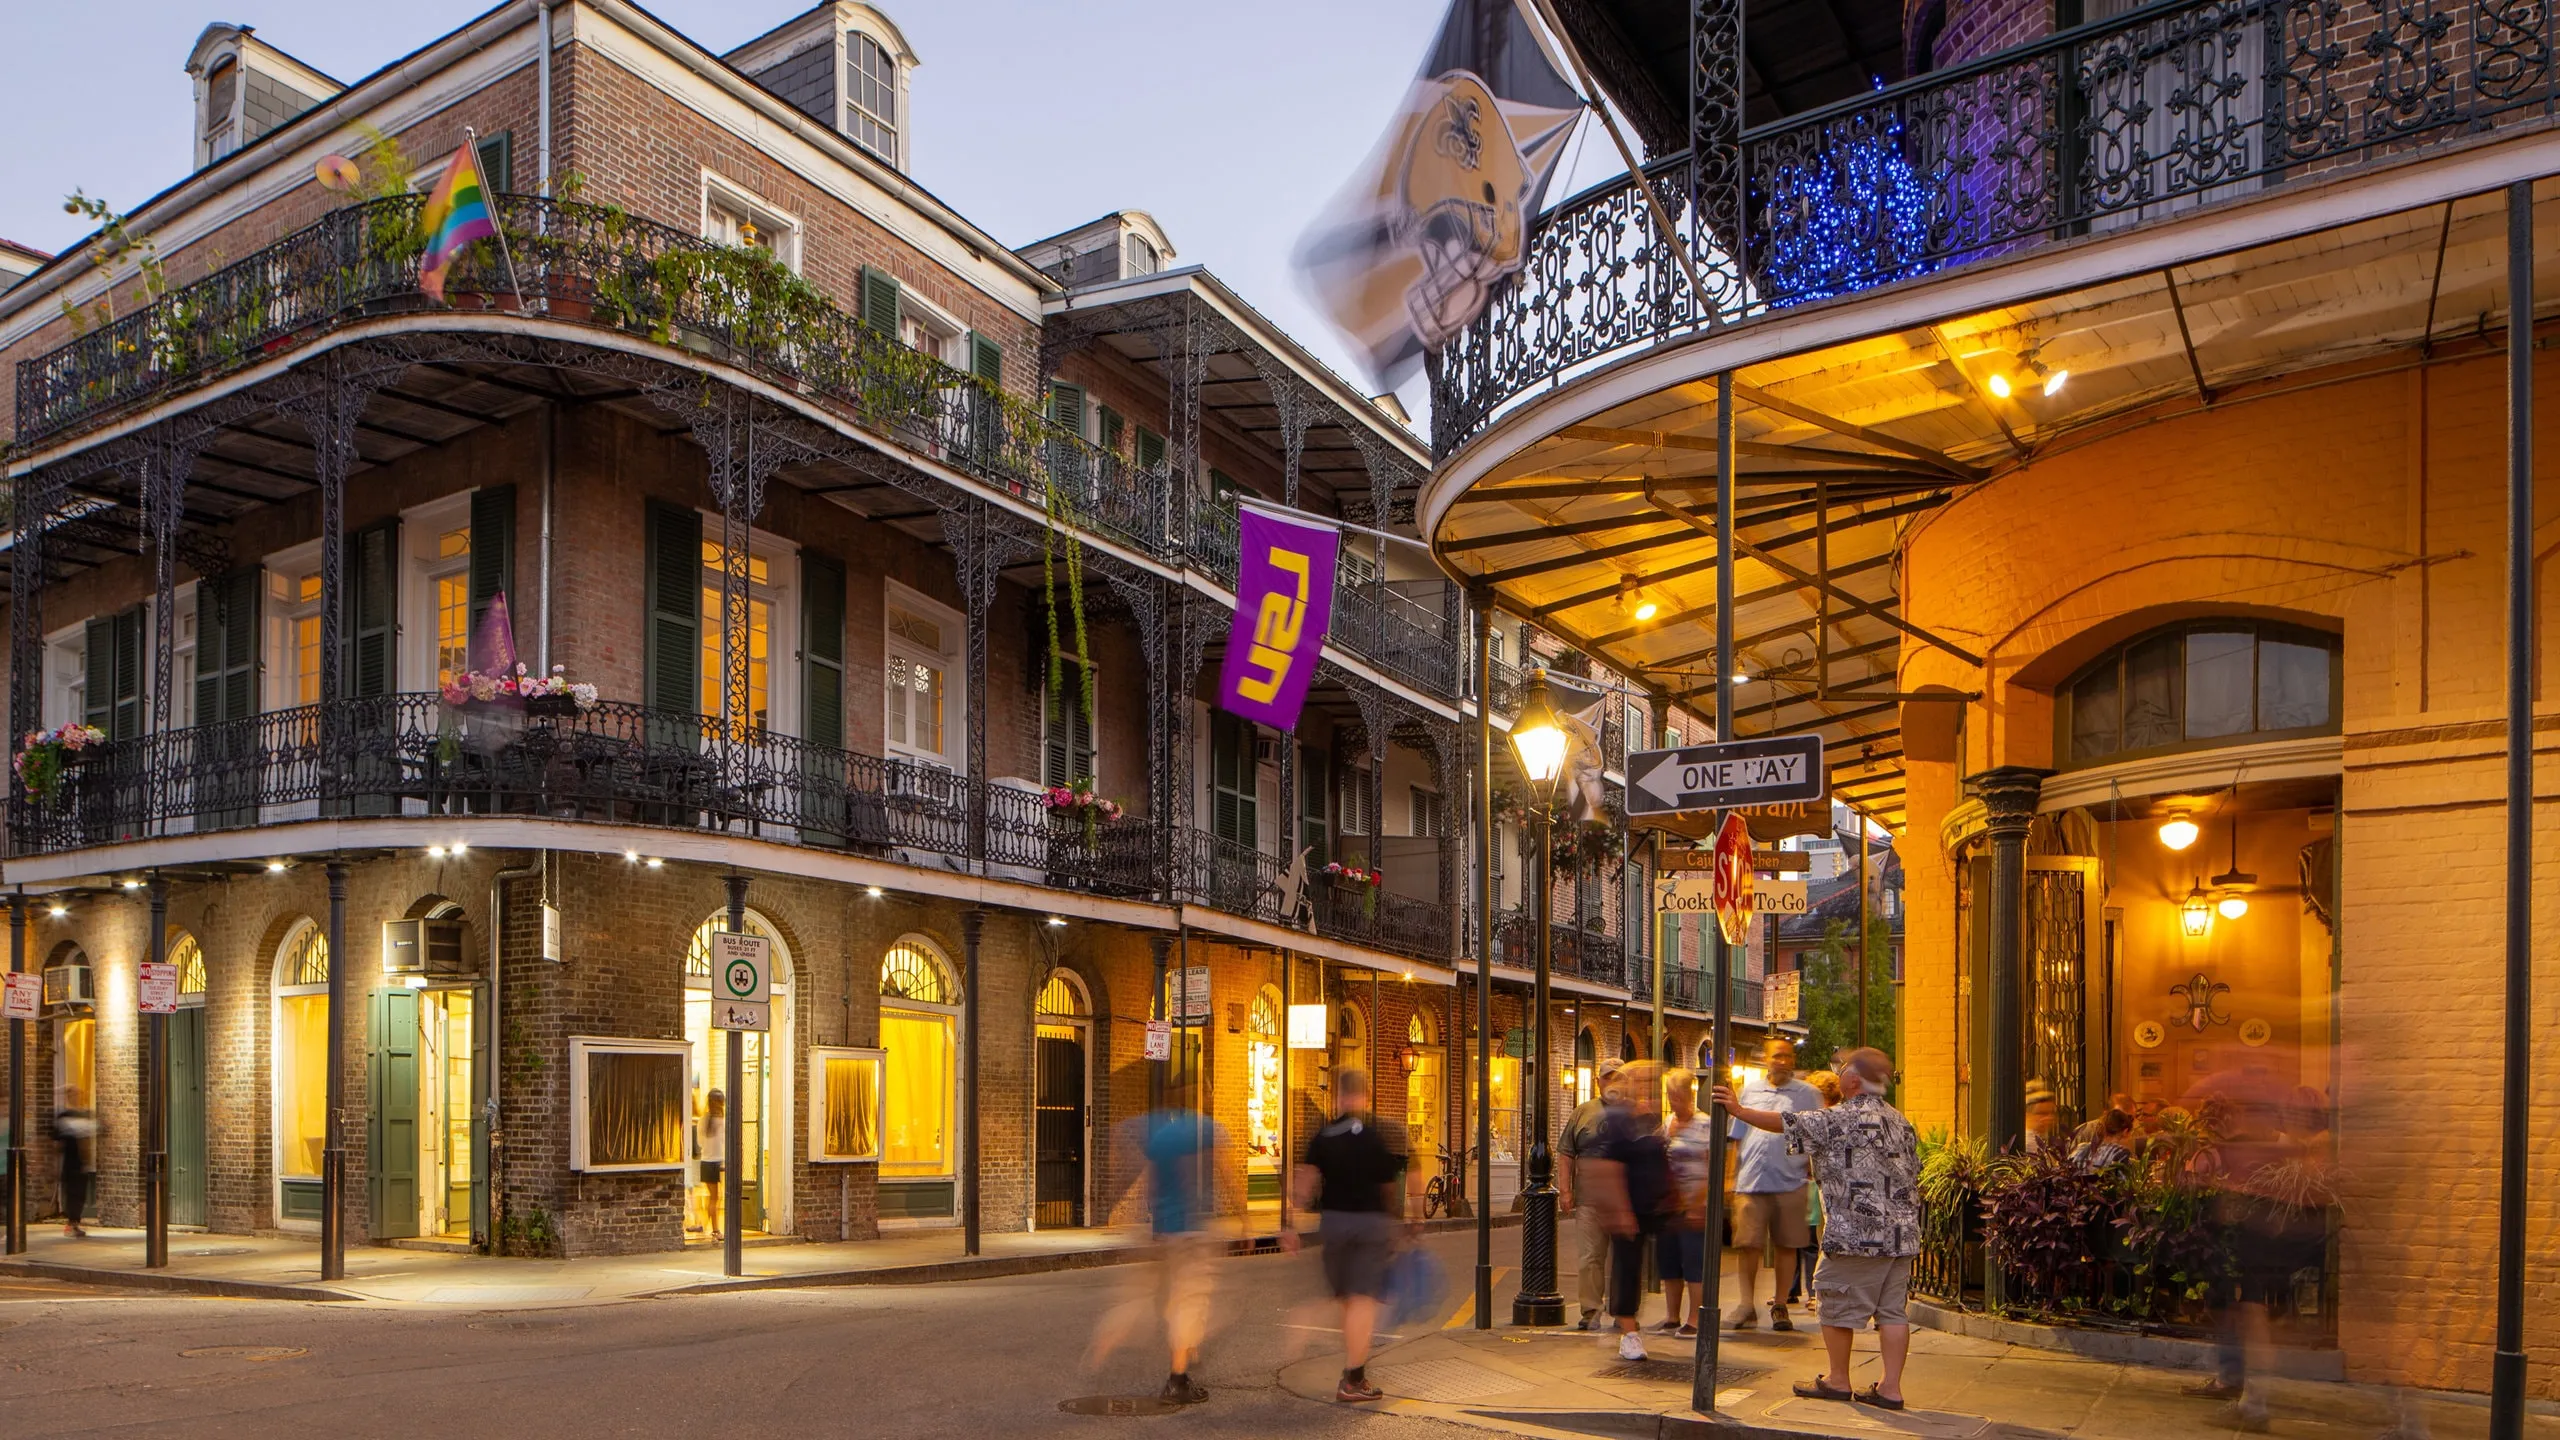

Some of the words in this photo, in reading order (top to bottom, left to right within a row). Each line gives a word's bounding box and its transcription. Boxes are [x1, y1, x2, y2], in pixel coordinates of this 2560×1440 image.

[1683, 763, 1733, 790] ONE
[1686, 852, 1714, 869] Caju
[1753, 852, 1780, 867] chen
[1717, 852, 1753, 906] STOP
[1662, 892, 1716, 911] Cockt
[1754, 892, 1805, 911] To-Go
[722, 937, 736, 945] BUS
[739, 939, 760, 948] ROUTE
[140, 966, 151, 977] NO
[151, 969, 176, 977] STOPPING
[12, 989, 32, 997] ANY
[12, 996, 32, 1006] TIME
